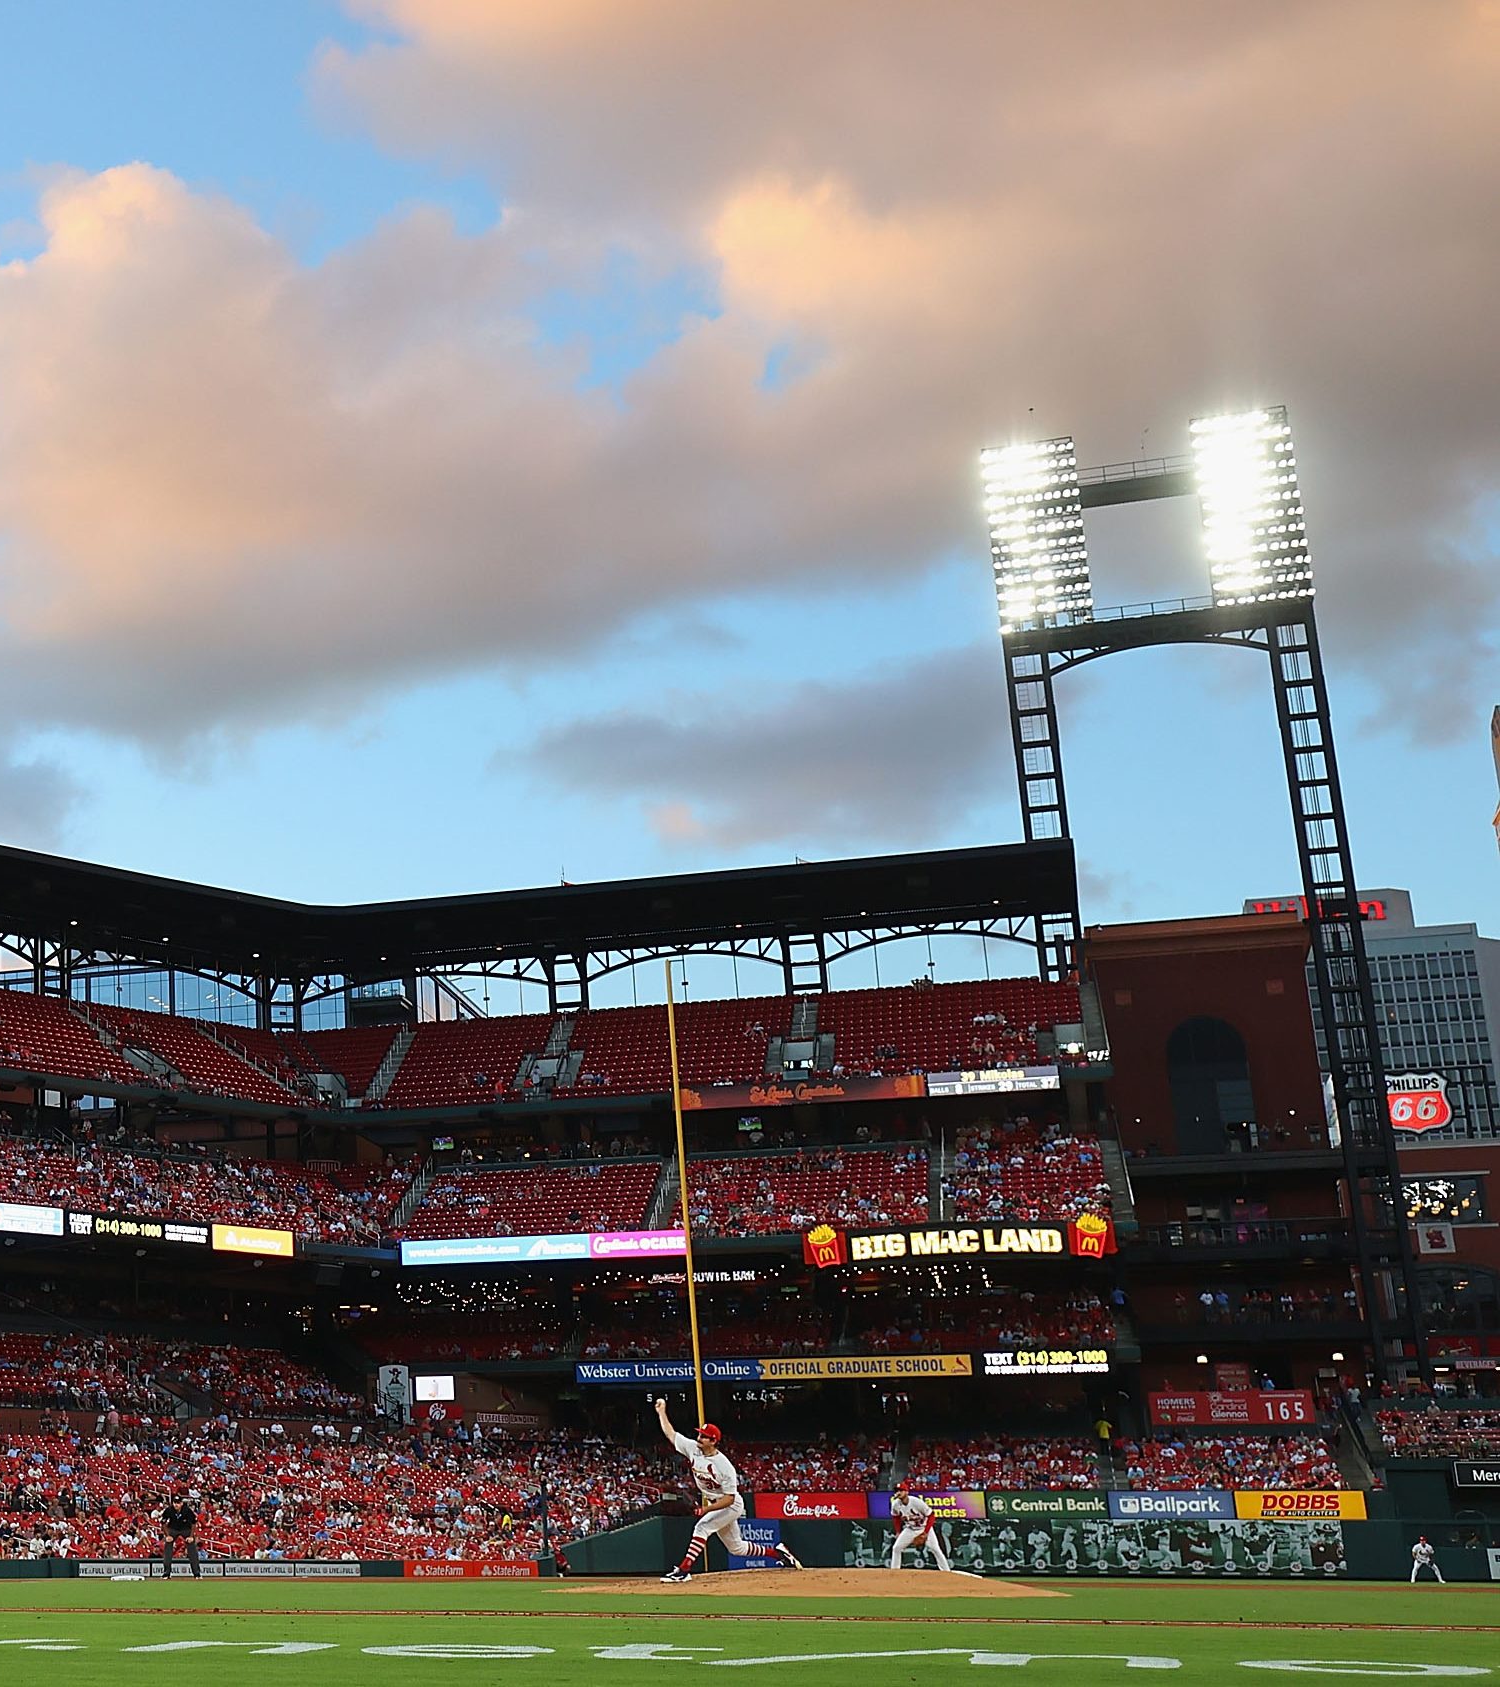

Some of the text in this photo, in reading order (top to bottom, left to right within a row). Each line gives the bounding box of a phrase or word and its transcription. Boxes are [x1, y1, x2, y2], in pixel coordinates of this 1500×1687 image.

[1252, 896, 1386, 920] Hiln
[960, 1069, 1025, 1082] 39 Mikolas
[1385, 1077, 1439, 1091] PHILLIPS
[795, 1082, 845, 1101] Cardinals
[1392, 1096, 1438, 1122] 66
[70, 1222, 92, 1235] TEXT
[95, 1217, 162, 1238] (314) 300-1000
[851, 1228, 1063, 1260] BIG MAC LAND
[984, 1350, 1107, 1366] TEXT (314) 300-1000
[1455, 1360, 1496, 1370] BEVERAGES
[578, 1364, 630, 1378] Webster
[635, 1362, 697, 1380] University
[704, 1362, 750, 1376] Online
[770, 1361, 823, 1375] OFFICIAL
[827, 1360, 892, 1375] GRADUATE
[896, 1358, 945, 1373] SCHOOL
[1157, 1398, 1195, 1406] HOMERS
[1210, 1401, 1248, 1411] Cardinal
[1211, 1410, 1248, 1418] Glennon
[1472, 1469, 1500, 1481] Mer
[1011, 1497, 1106, 1511] Central Bank
[1141, 1495, 1221, 1515] Ballpark
[1262, 1495, 1339, 1510] DOBBS
